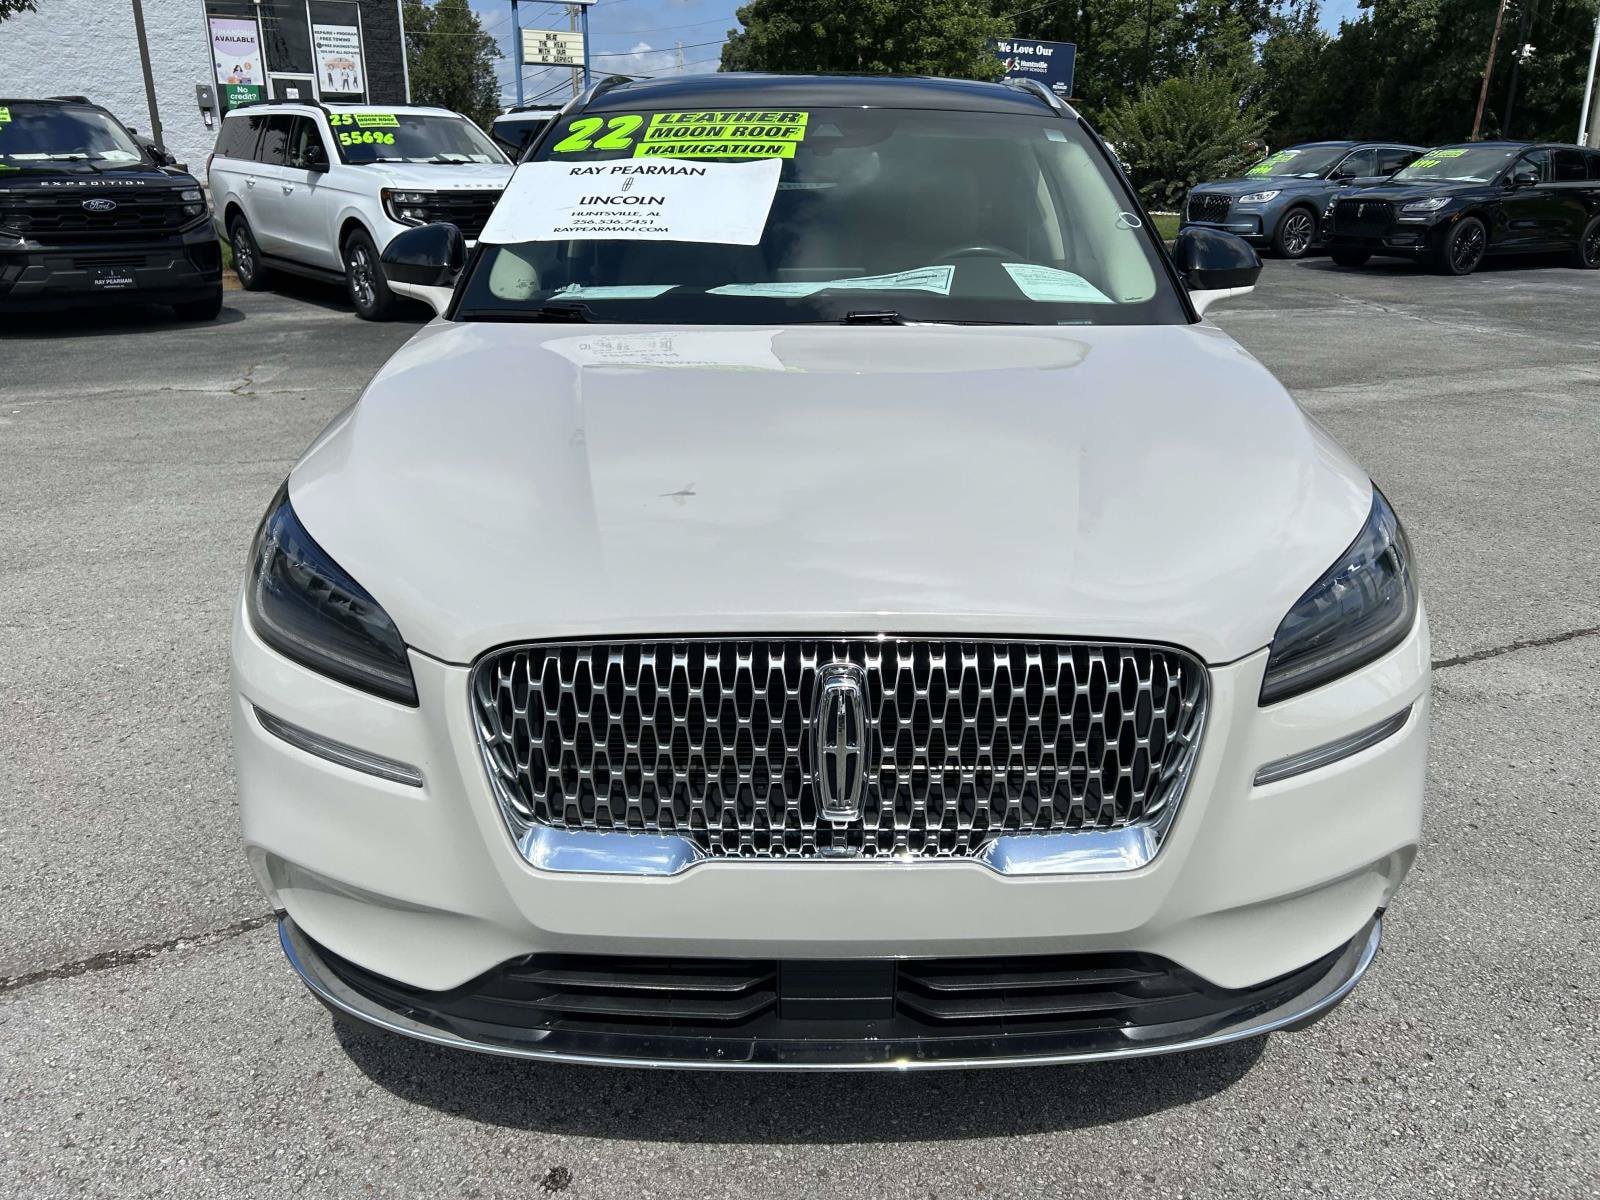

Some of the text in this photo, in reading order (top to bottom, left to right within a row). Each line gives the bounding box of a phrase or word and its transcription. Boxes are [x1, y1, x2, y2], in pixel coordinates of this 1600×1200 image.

[214, 35, 256, 44] AVAILABLE
[545, 33, 558, 41] BEAT
[538, 40, 567, 49] THE HEAT
[997, 42, 1054, 56] We Love Our
[1020, 60, 1048, 69] Huntsville
[236, 86, 249, 94] No
[329, 113, 354, 126] 25
[658, 112, 802, 124] LEATHER
[554, 114, 645, 153] 22
[649, 126, 798, 139] MOON ROOF
[339, 131, 396, 146] 55696
[644, 144, 783, 155] NAVIGATION
[569, 165, 707, 176] RAY PEARMAN
[88, 200, 111, 210] Ford
[578, 196, 666, 206] LINCOLN
